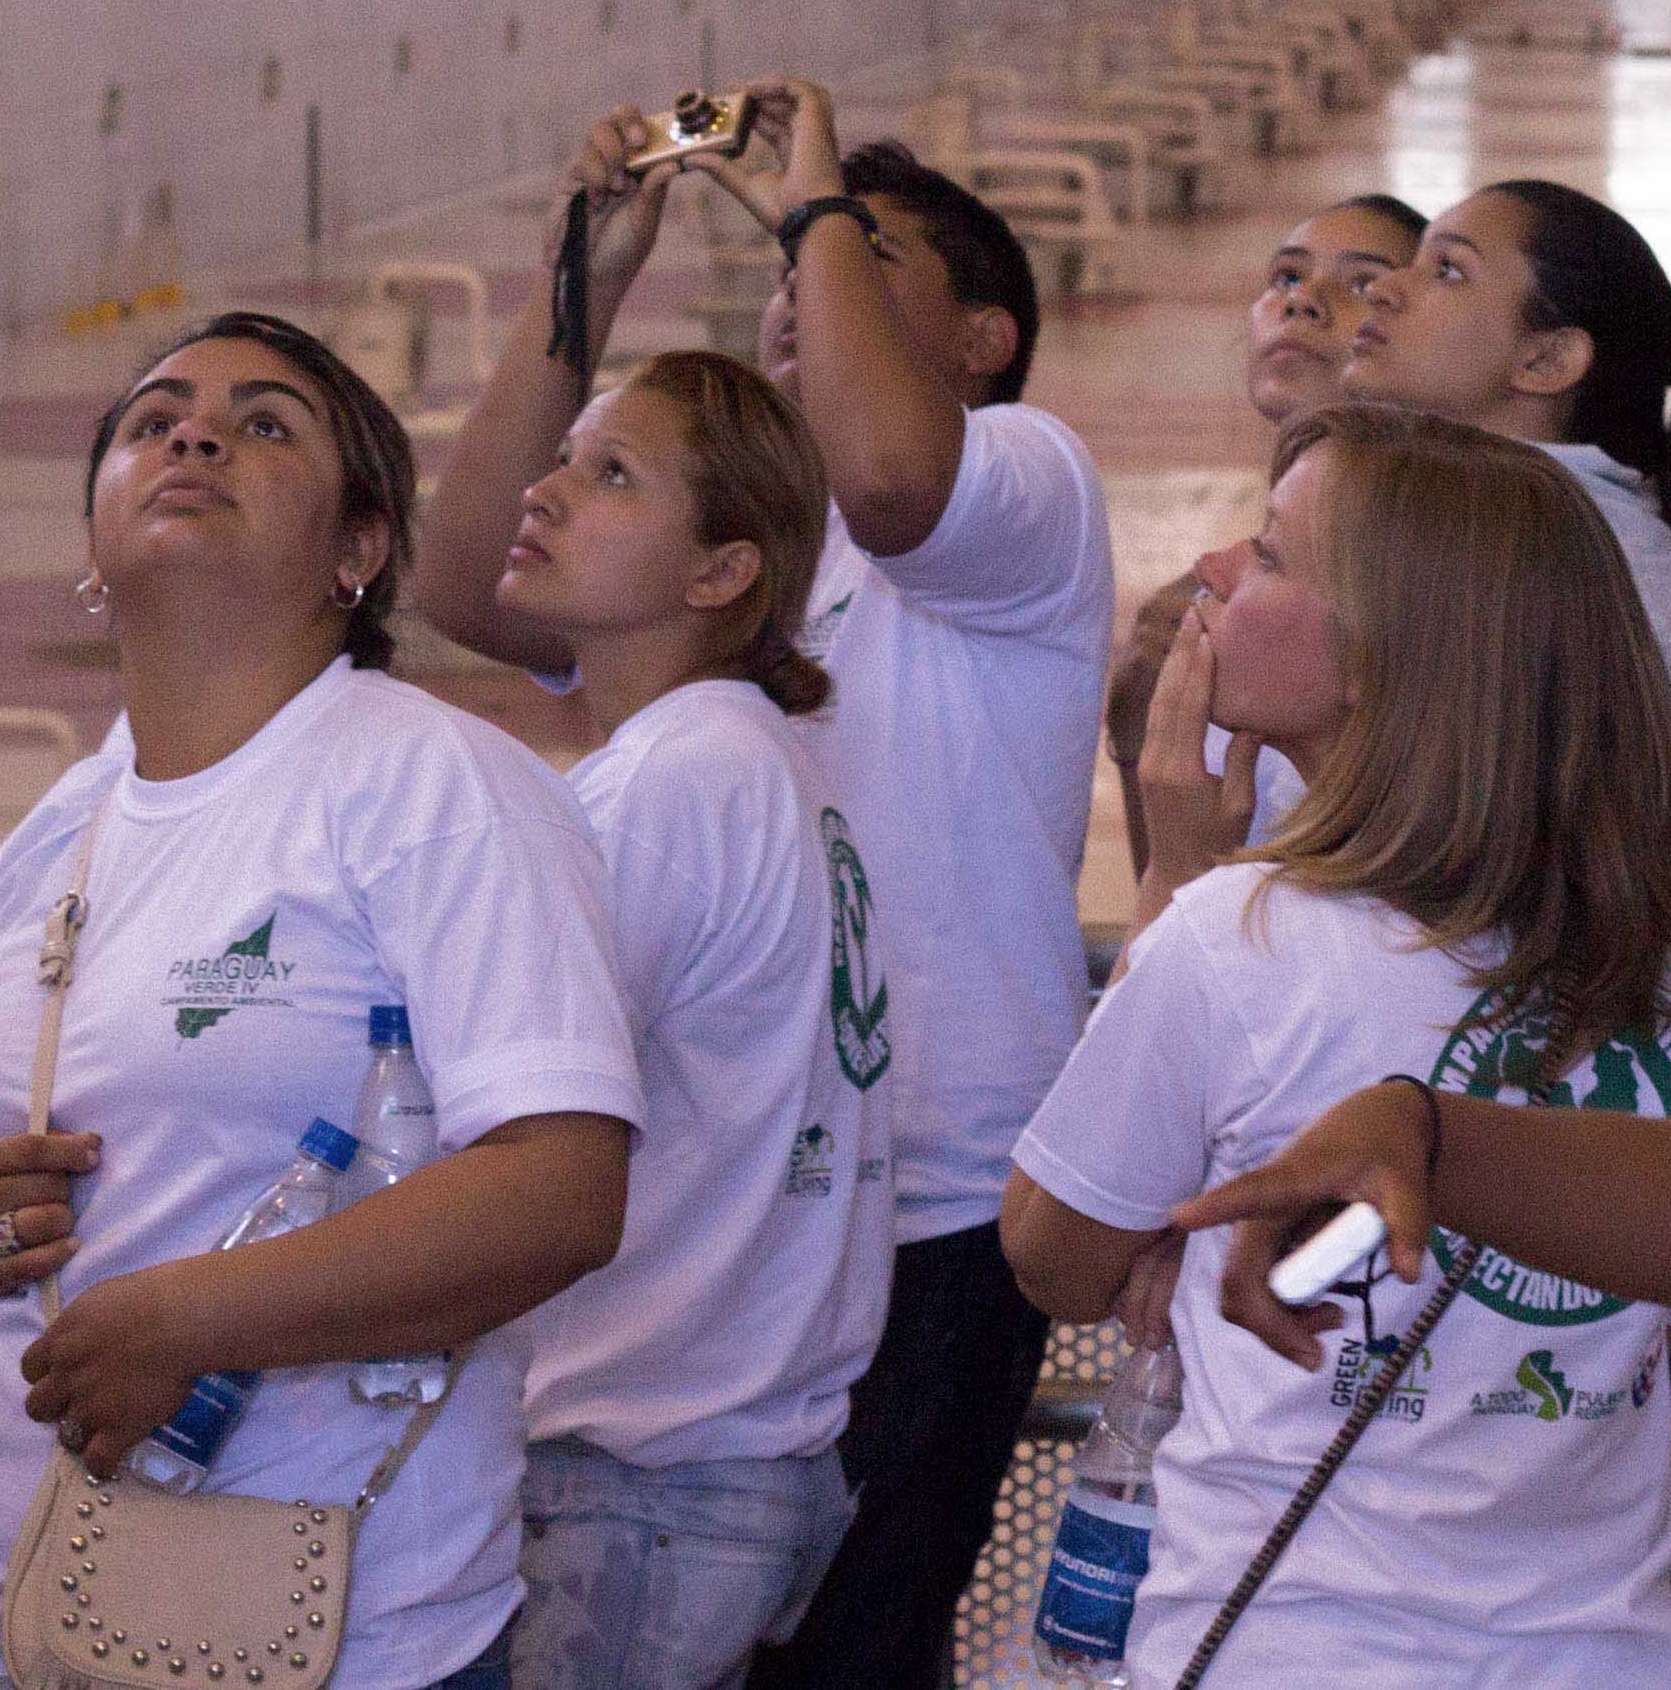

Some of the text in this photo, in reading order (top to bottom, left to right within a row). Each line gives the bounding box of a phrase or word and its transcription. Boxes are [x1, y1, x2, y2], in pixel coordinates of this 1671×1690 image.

[167, 956, 296, 982] PARAGUAY
[185, 980, 260, 994] VERDE IV
[1330, 1337, 1363, 1407] GREEN
